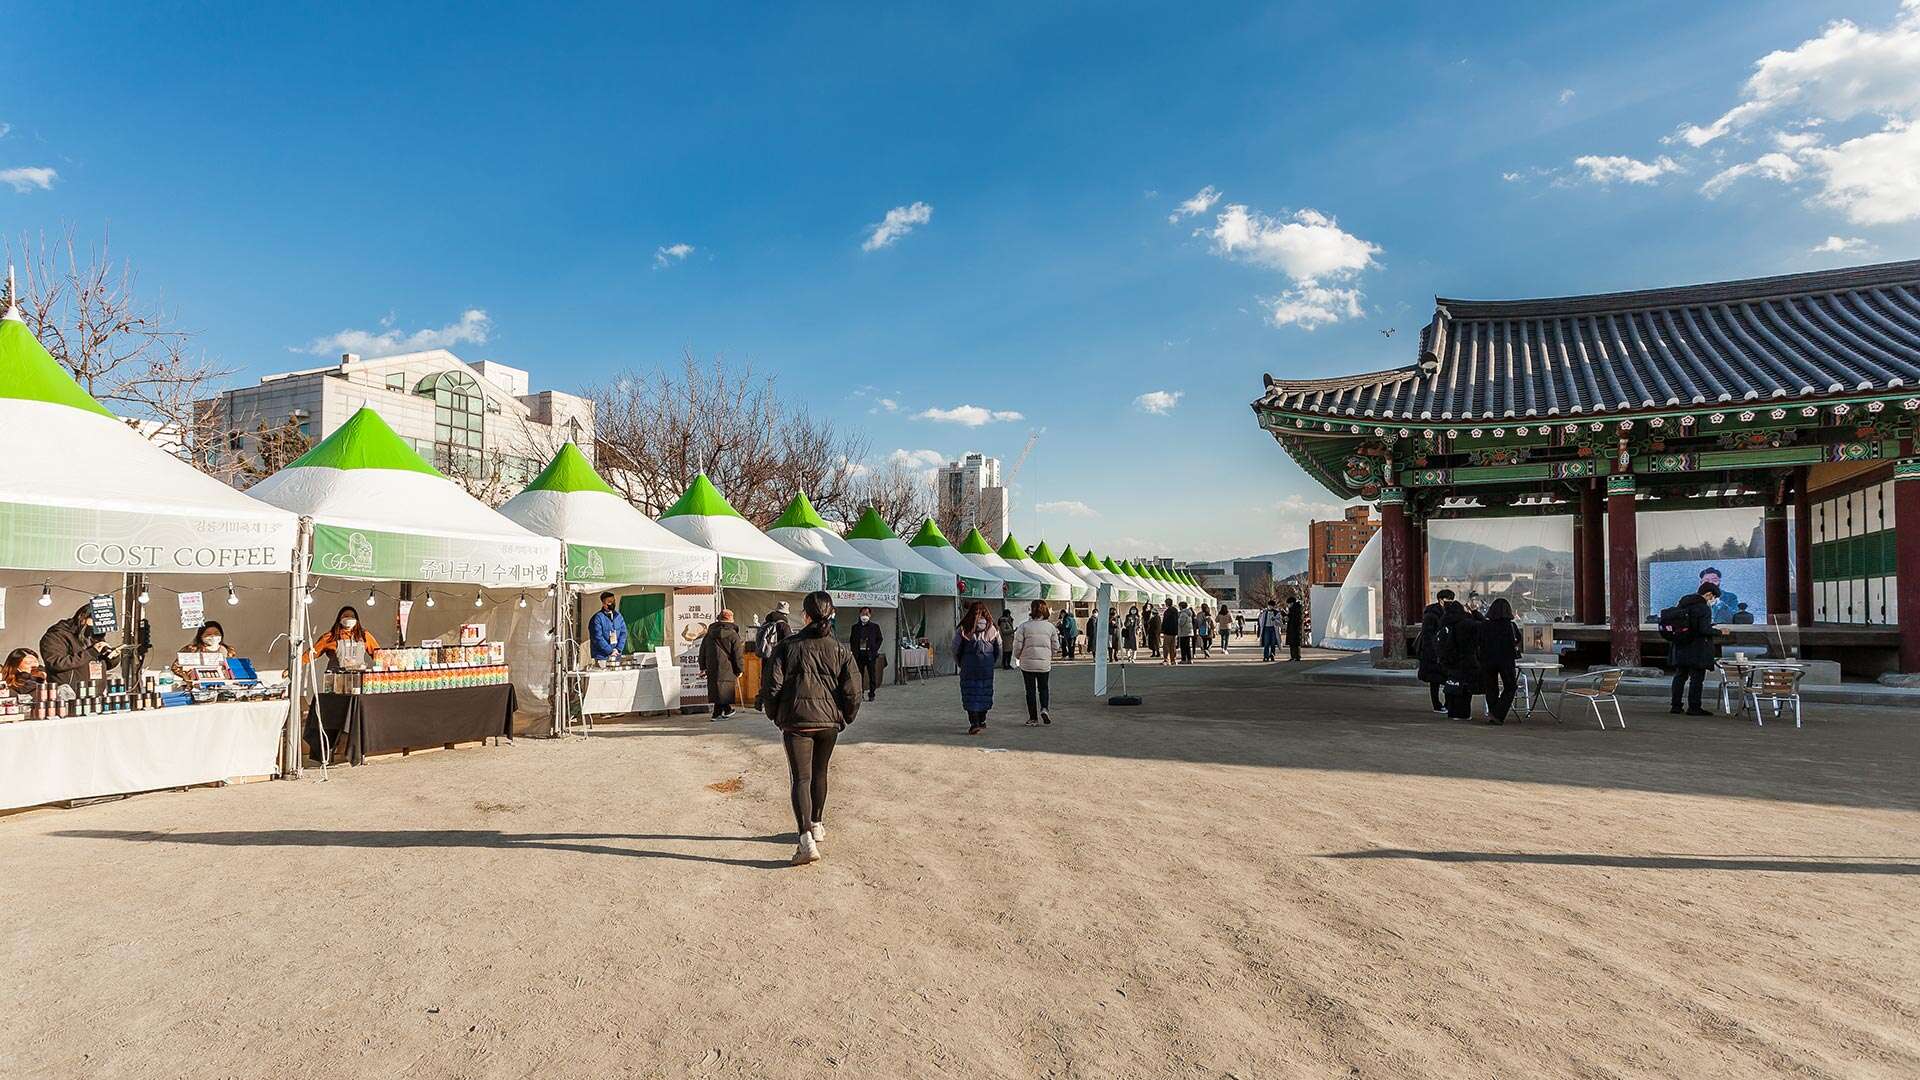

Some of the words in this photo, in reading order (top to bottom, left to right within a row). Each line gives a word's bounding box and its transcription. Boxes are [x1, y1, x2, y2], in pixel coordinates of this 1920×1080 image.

[76, 543, 164, 567] COST
[173, 546, 277, 568] COFFEE
[492, 563, 549, 582] 수제머랭
